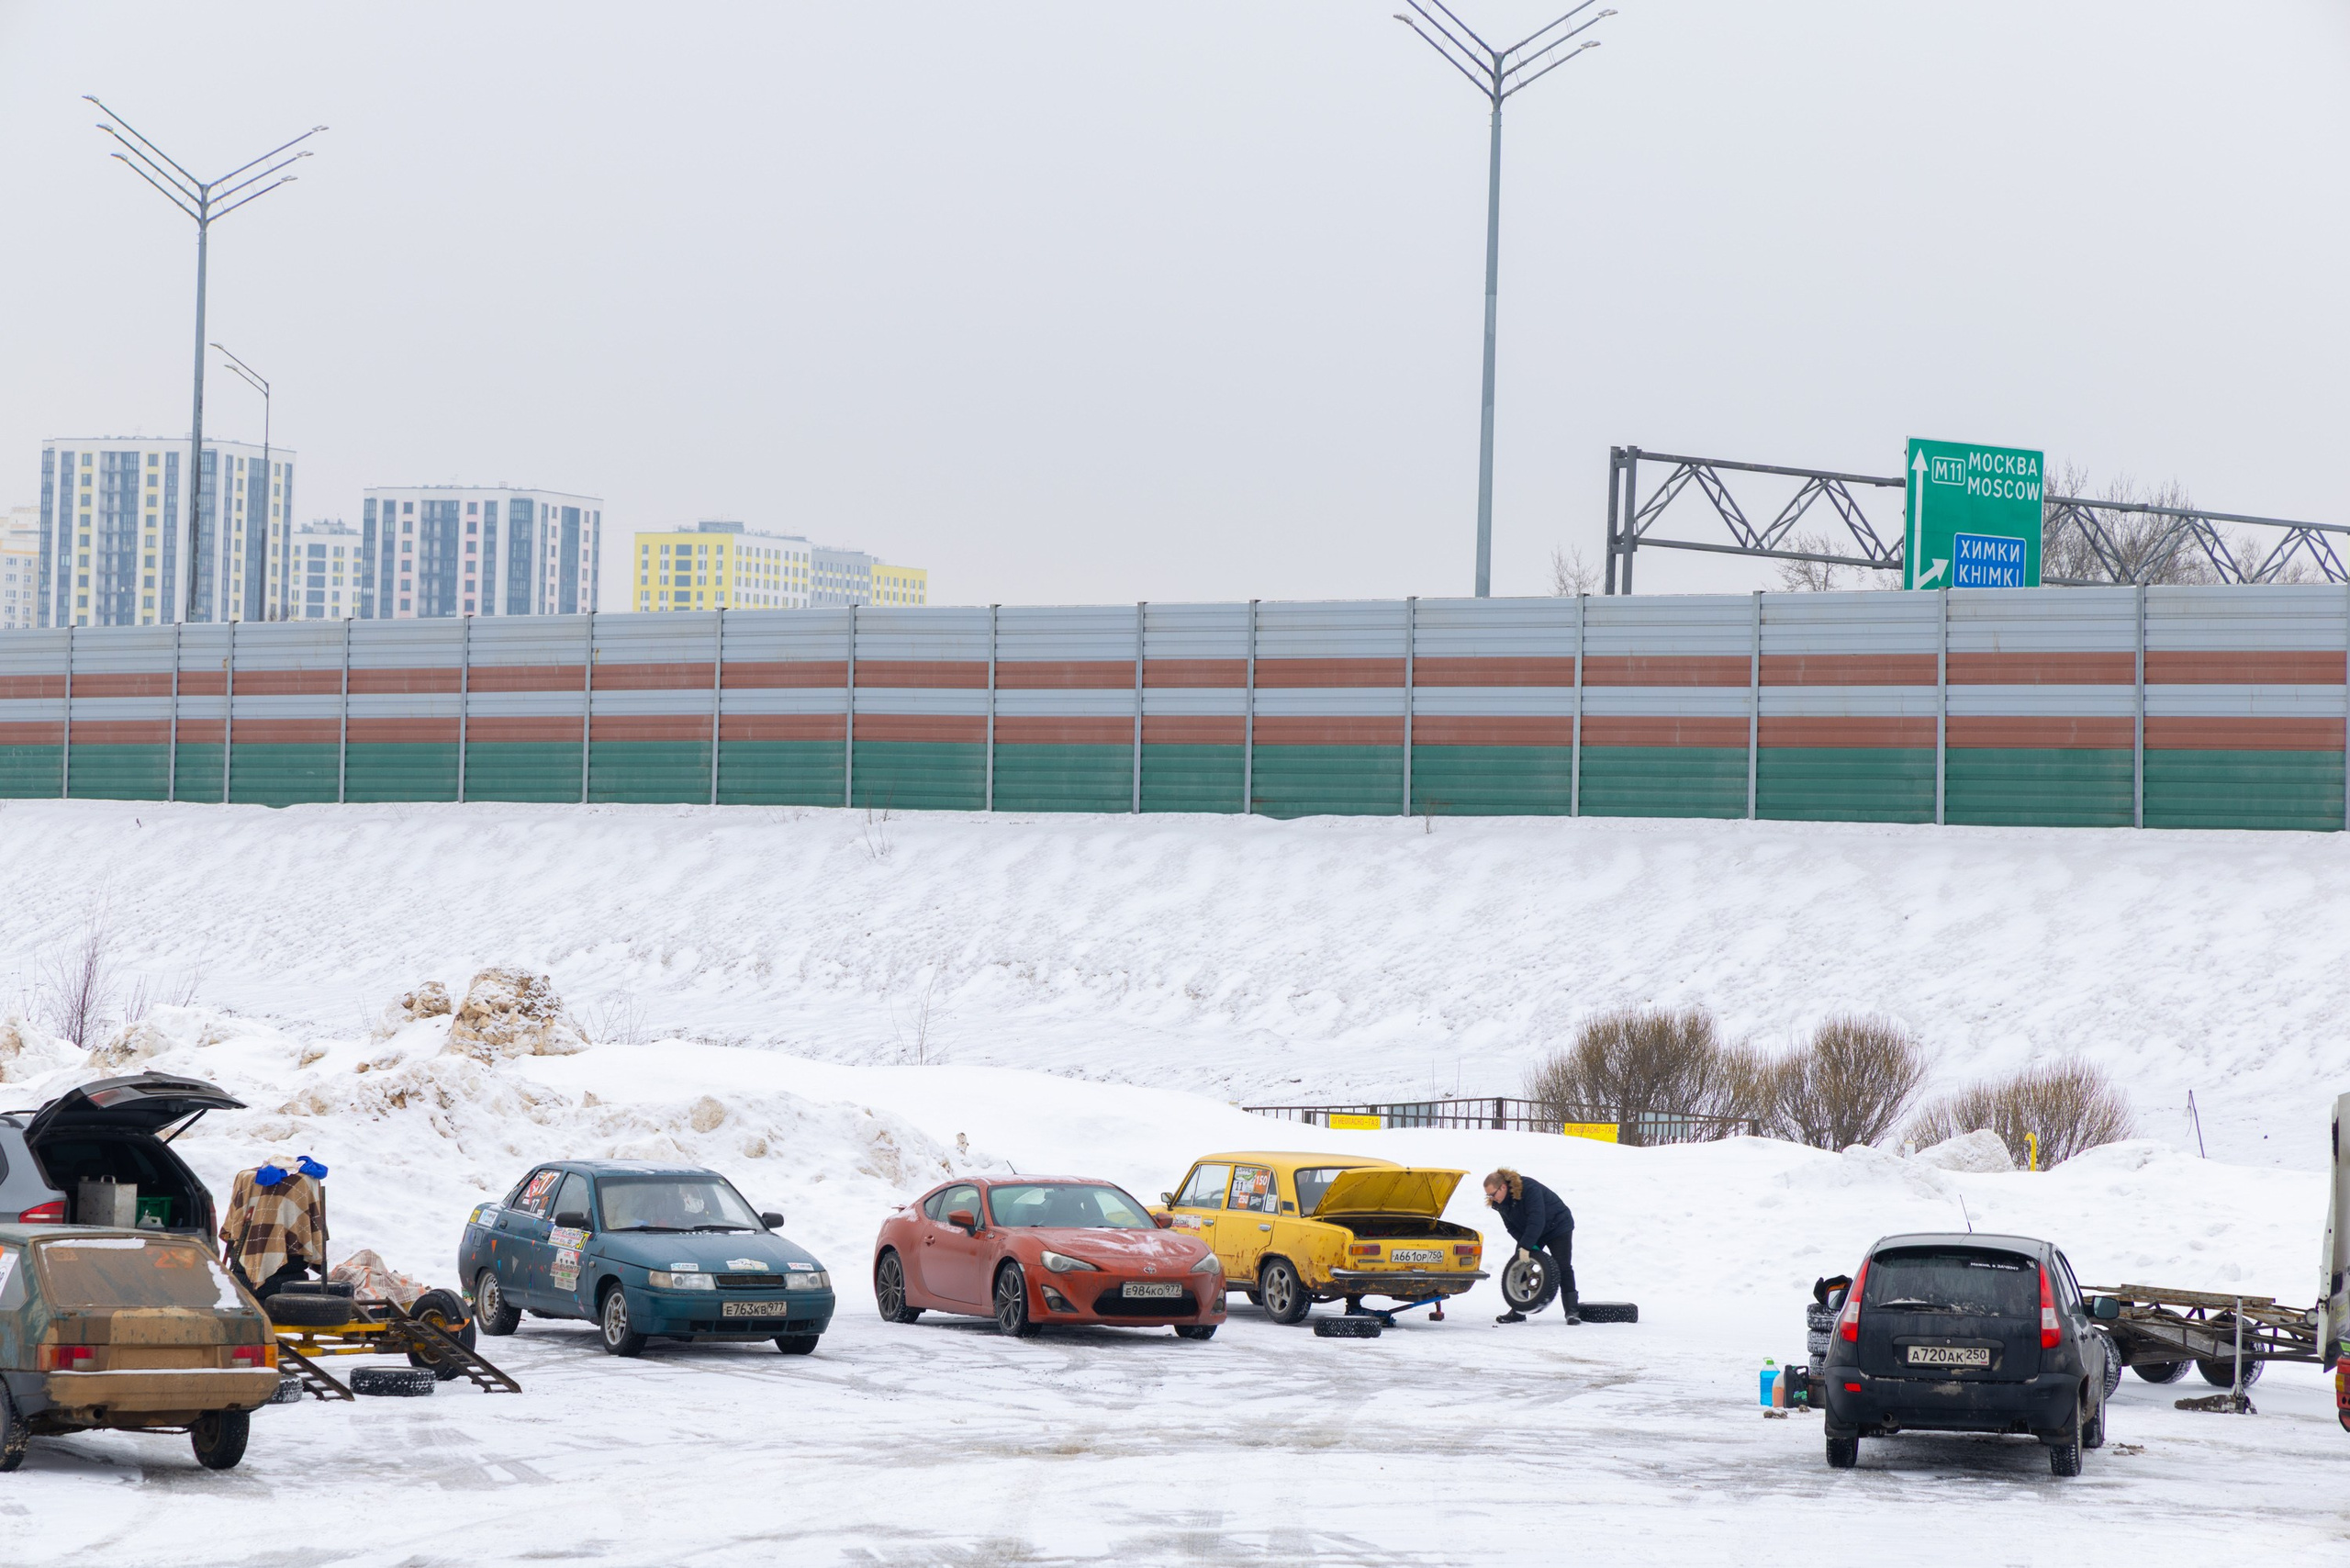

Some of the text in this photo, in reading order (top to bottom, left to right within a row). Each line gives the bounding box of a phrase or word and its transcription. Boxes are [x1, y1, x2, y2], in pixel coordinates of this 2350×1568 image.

[1934, 452, 2038, 482] М11 МОСКВА
[1967, 476, 2040, 501] MOSCOW
[1960, 540, 2020, 563] ХИМКИ
[1959, 564, 2020, 587] KHIMKI
[1256, 1175, 1268, 1186] 150
[1393, 1251, 1427, 1261] А661ОР
[1125, 1285, 1164, 1296] Е984КО
[725, 1301, 784, 1316] Е763КВ 977
[1911, 1348, 1986, 1362] А720АК 250
